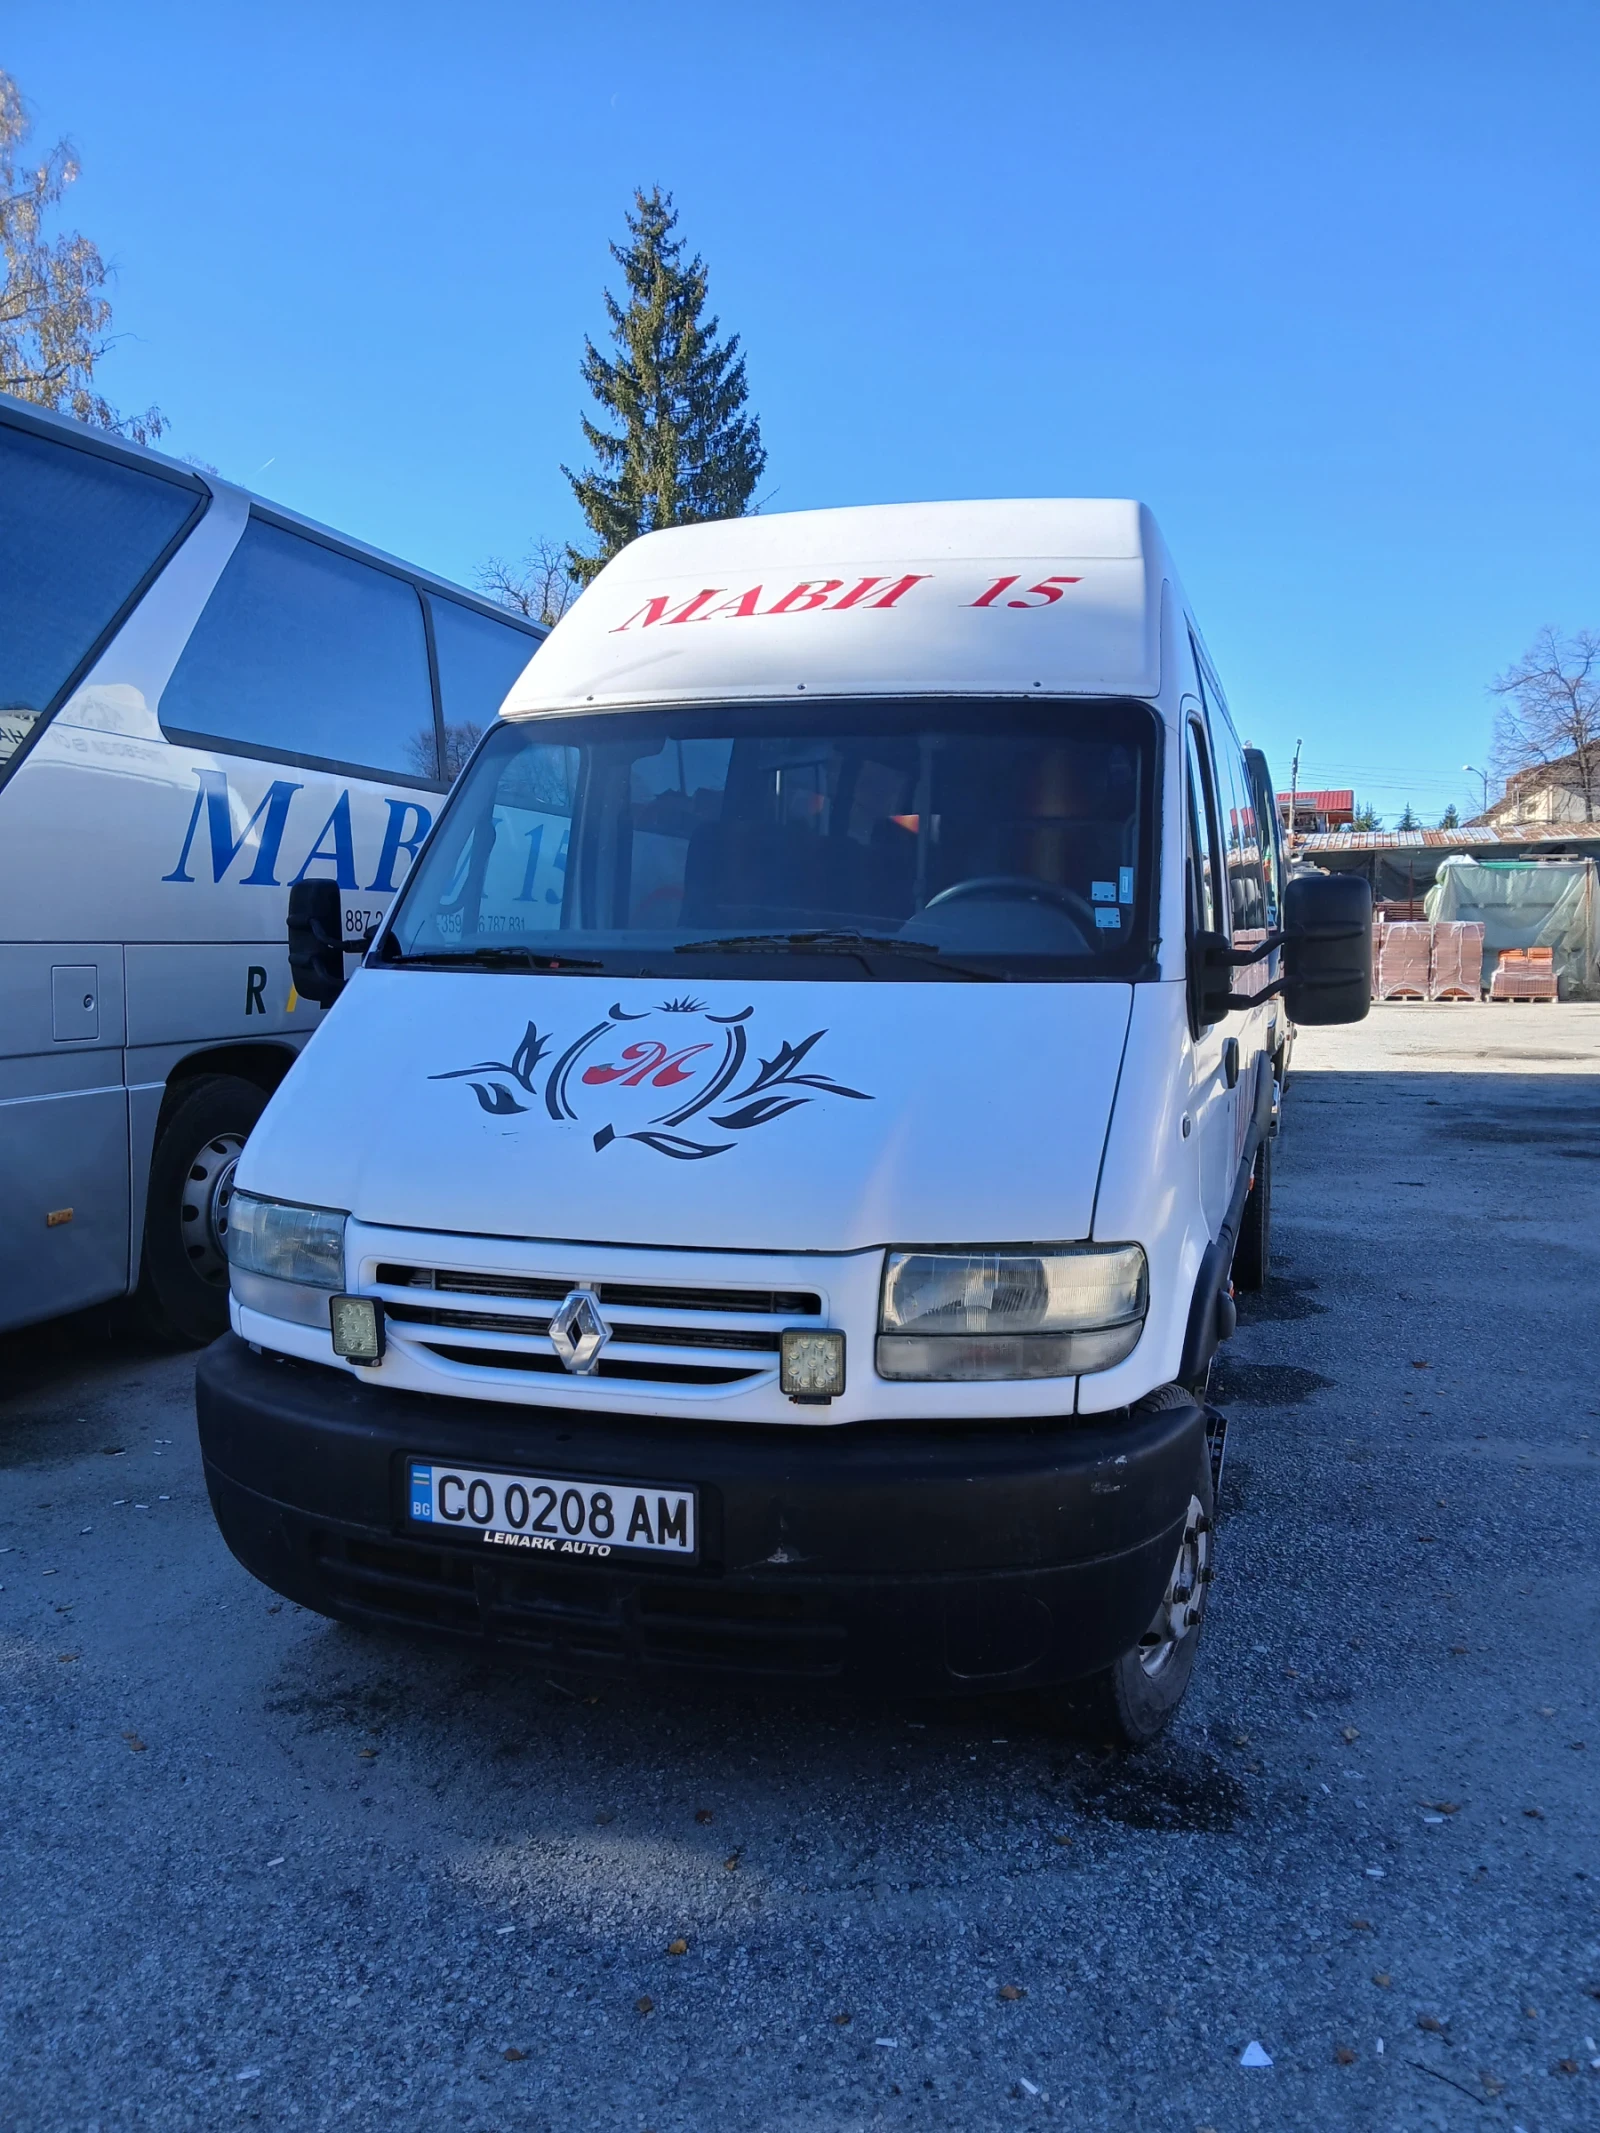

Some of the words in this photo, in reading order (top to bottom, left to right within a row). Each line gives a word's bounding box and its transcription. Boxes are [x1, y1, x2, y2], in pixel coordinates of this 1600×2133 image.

[608, 574, 935, 633] МАВИ
[958, 574, 1085, 608] 15
[345, 910, 371, 932] 887
[488, 915, 506, 932] 787
[412, 1501, 431, 1516] BG
[438, 1474, 494, 1525] CO
[505, 1482, 614, 1539] 0208
[626, 1495, 687, 1547] AM
[483, 1530, 555, 1551] LEMARK
[561, 1540, 611, 1557] AUTO
